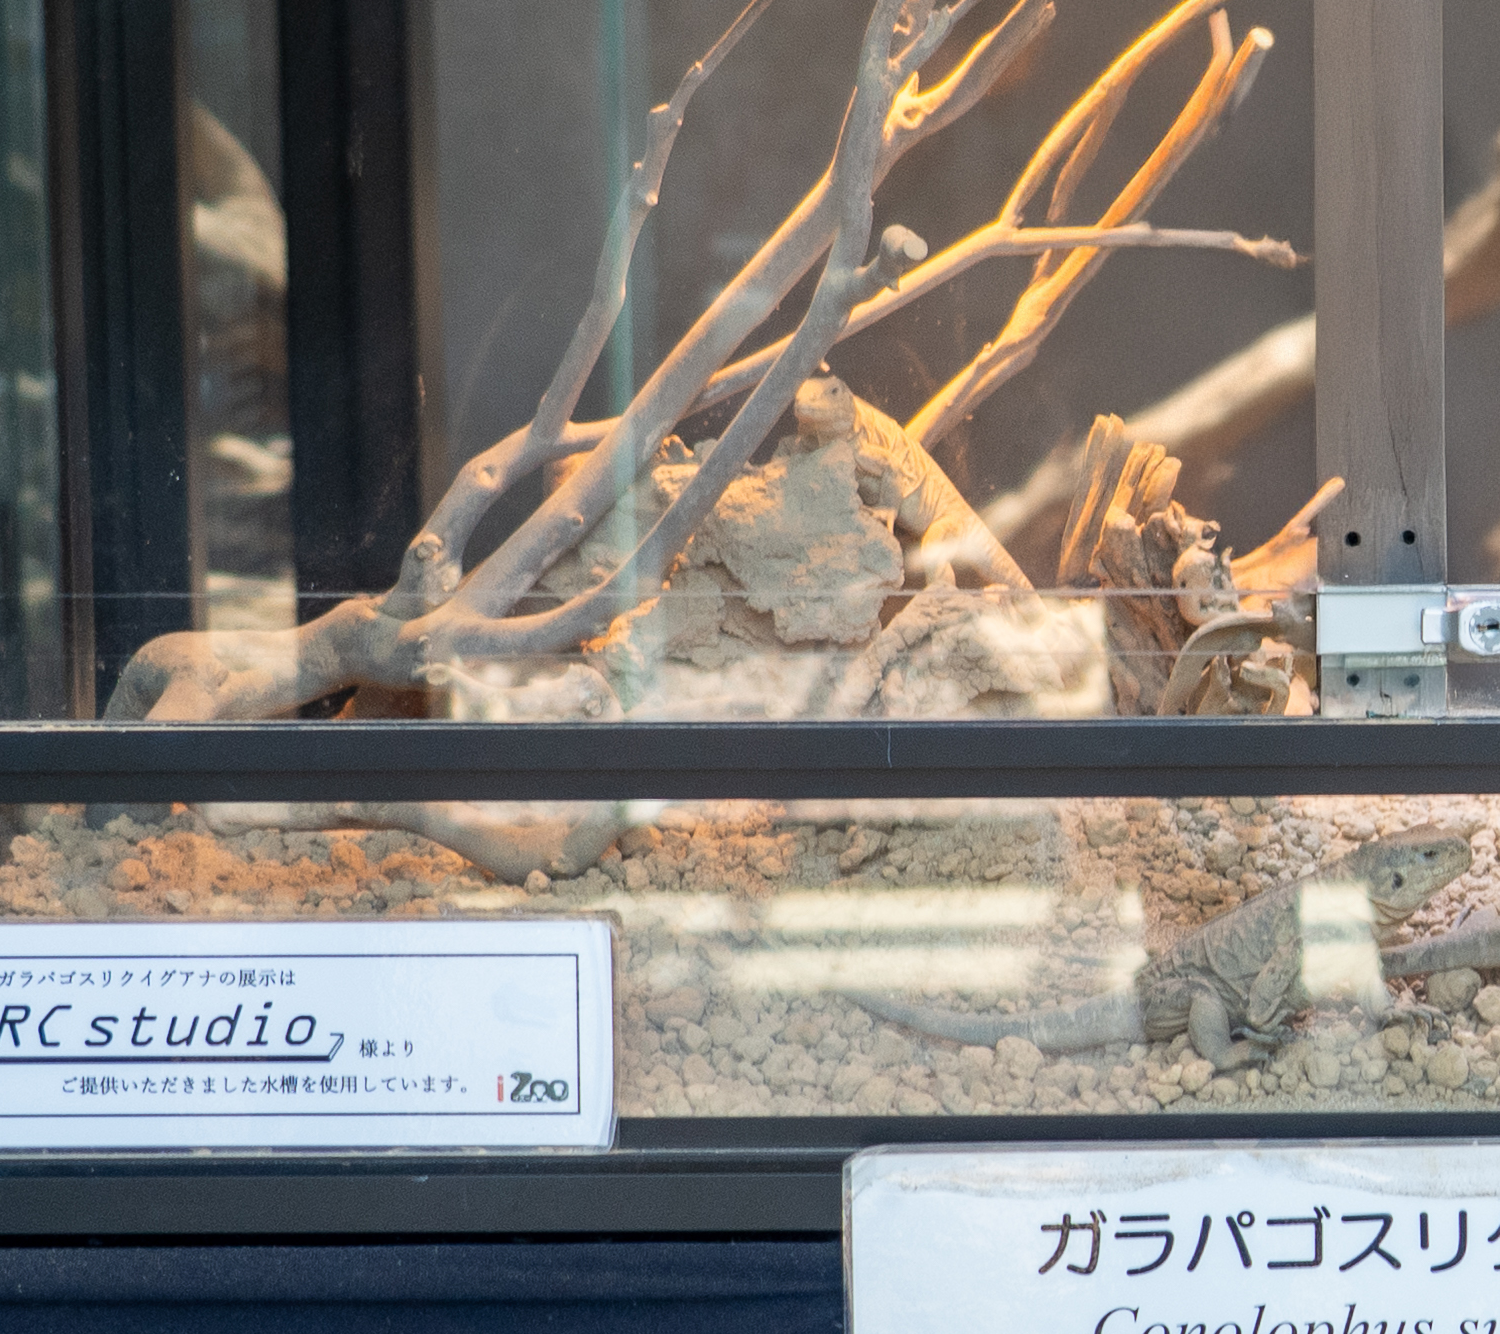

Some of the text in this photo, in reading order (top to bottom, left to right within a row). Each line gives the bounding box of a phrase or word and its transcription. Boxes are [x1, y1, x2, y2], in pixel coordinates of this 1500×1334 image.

[359, 1037, 415, 1060] 様より
[62, 1074, 471, 1096] ご提供いただきました水槽を使用しています。
